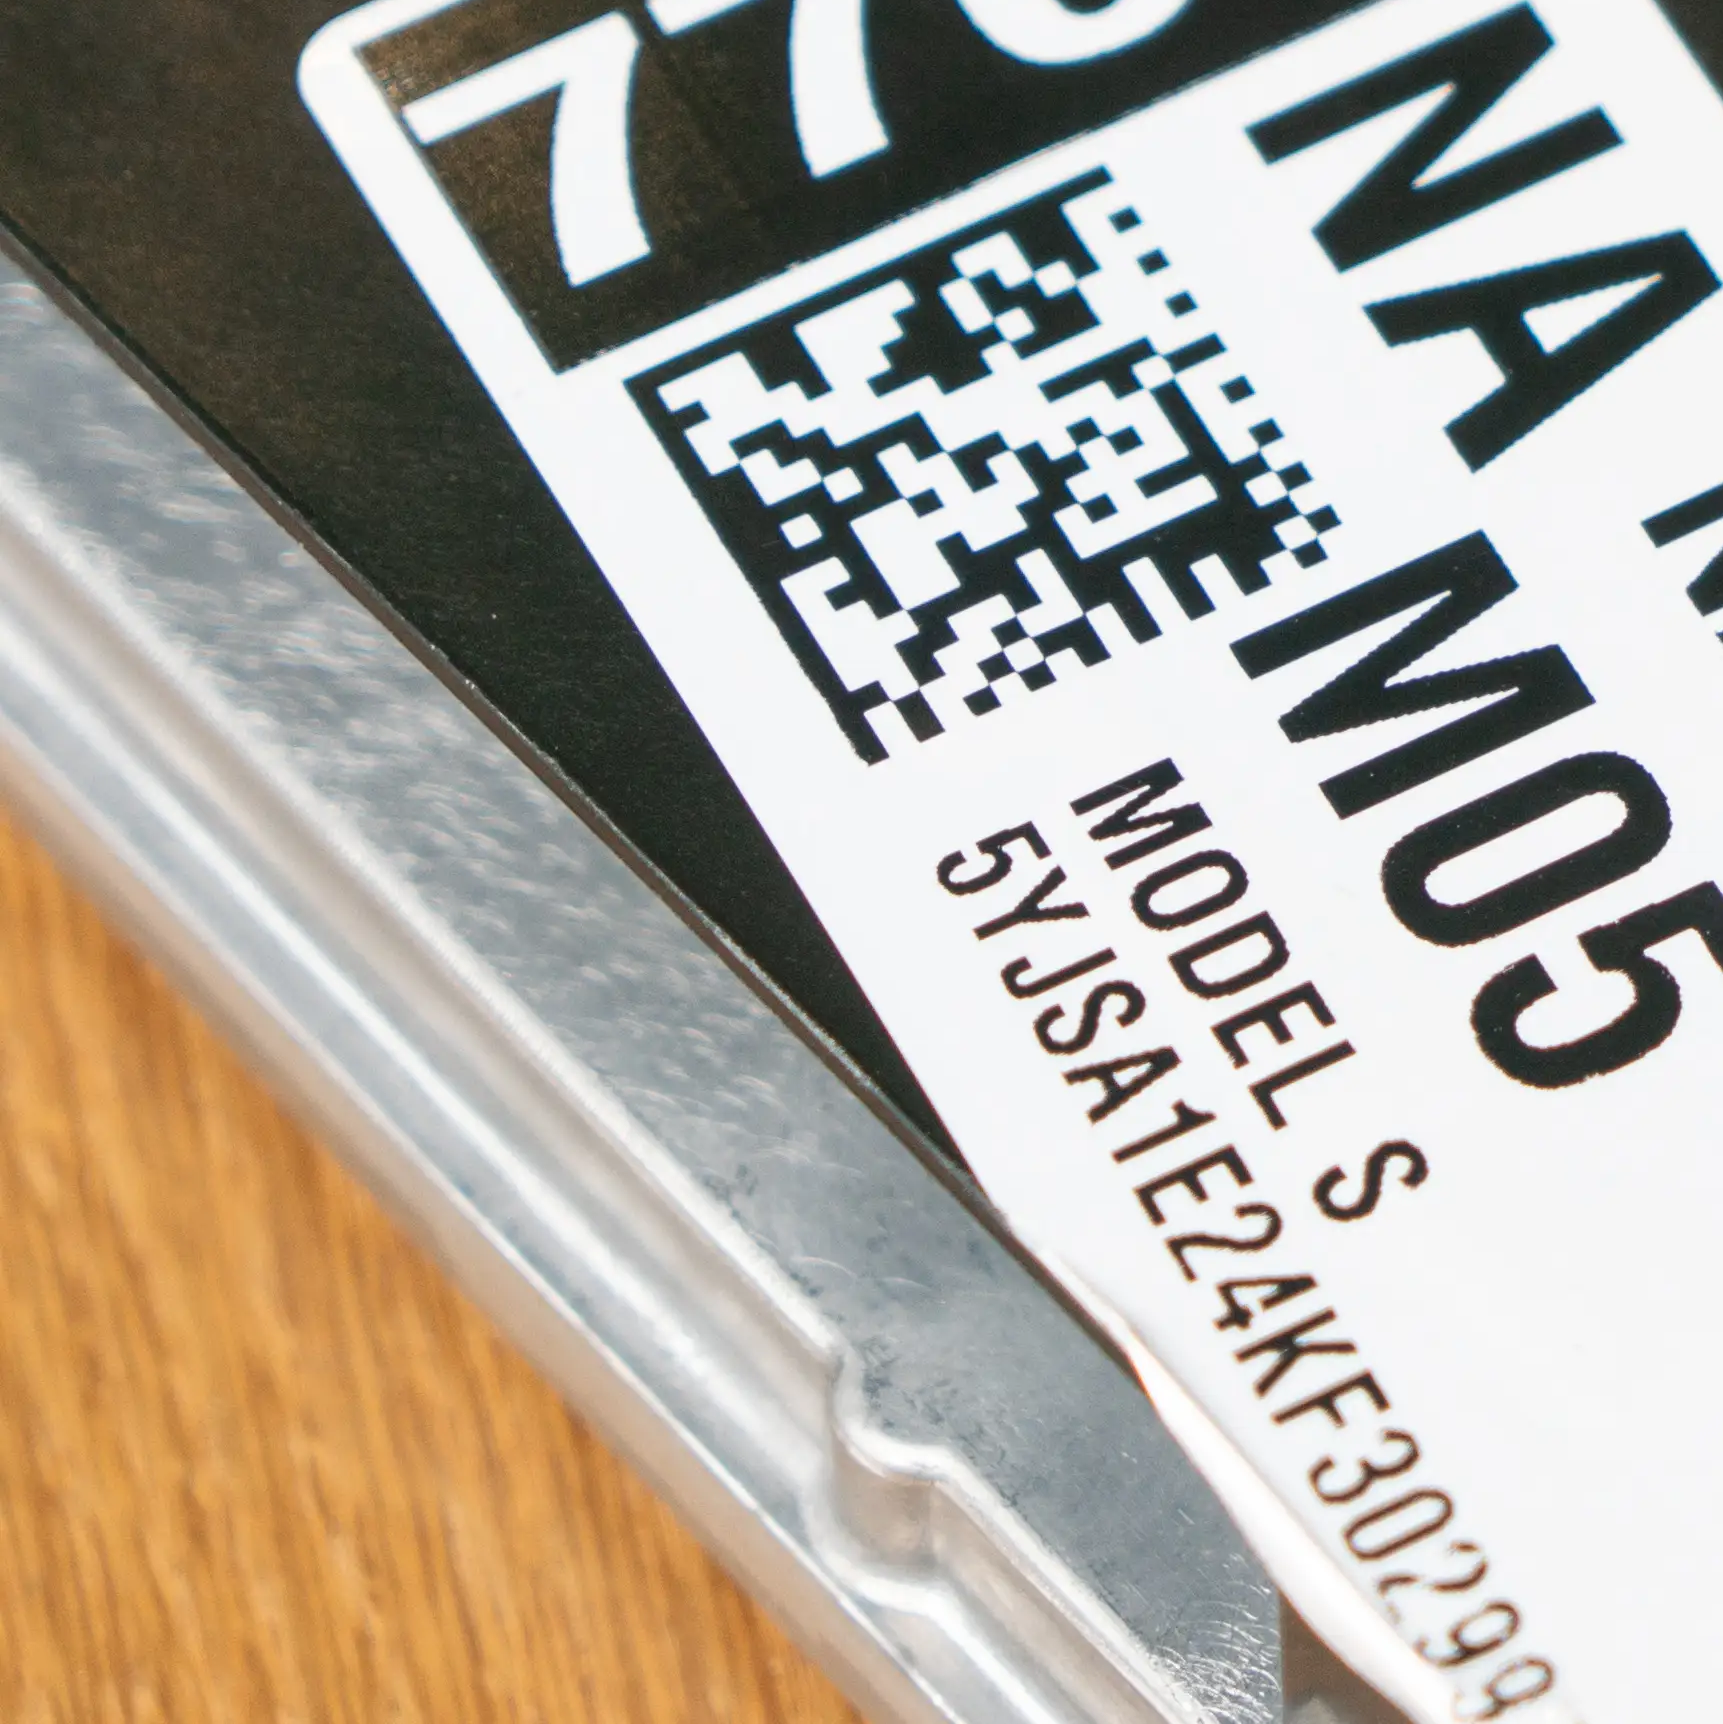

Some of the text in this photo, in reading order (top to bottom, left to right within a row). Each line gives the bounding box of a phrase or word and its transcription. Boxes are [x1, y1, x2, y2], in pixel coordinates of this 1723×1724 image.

[1246, 2, 1722, 472] NA
[1070, 758, 1428, 1221] MODEL S
